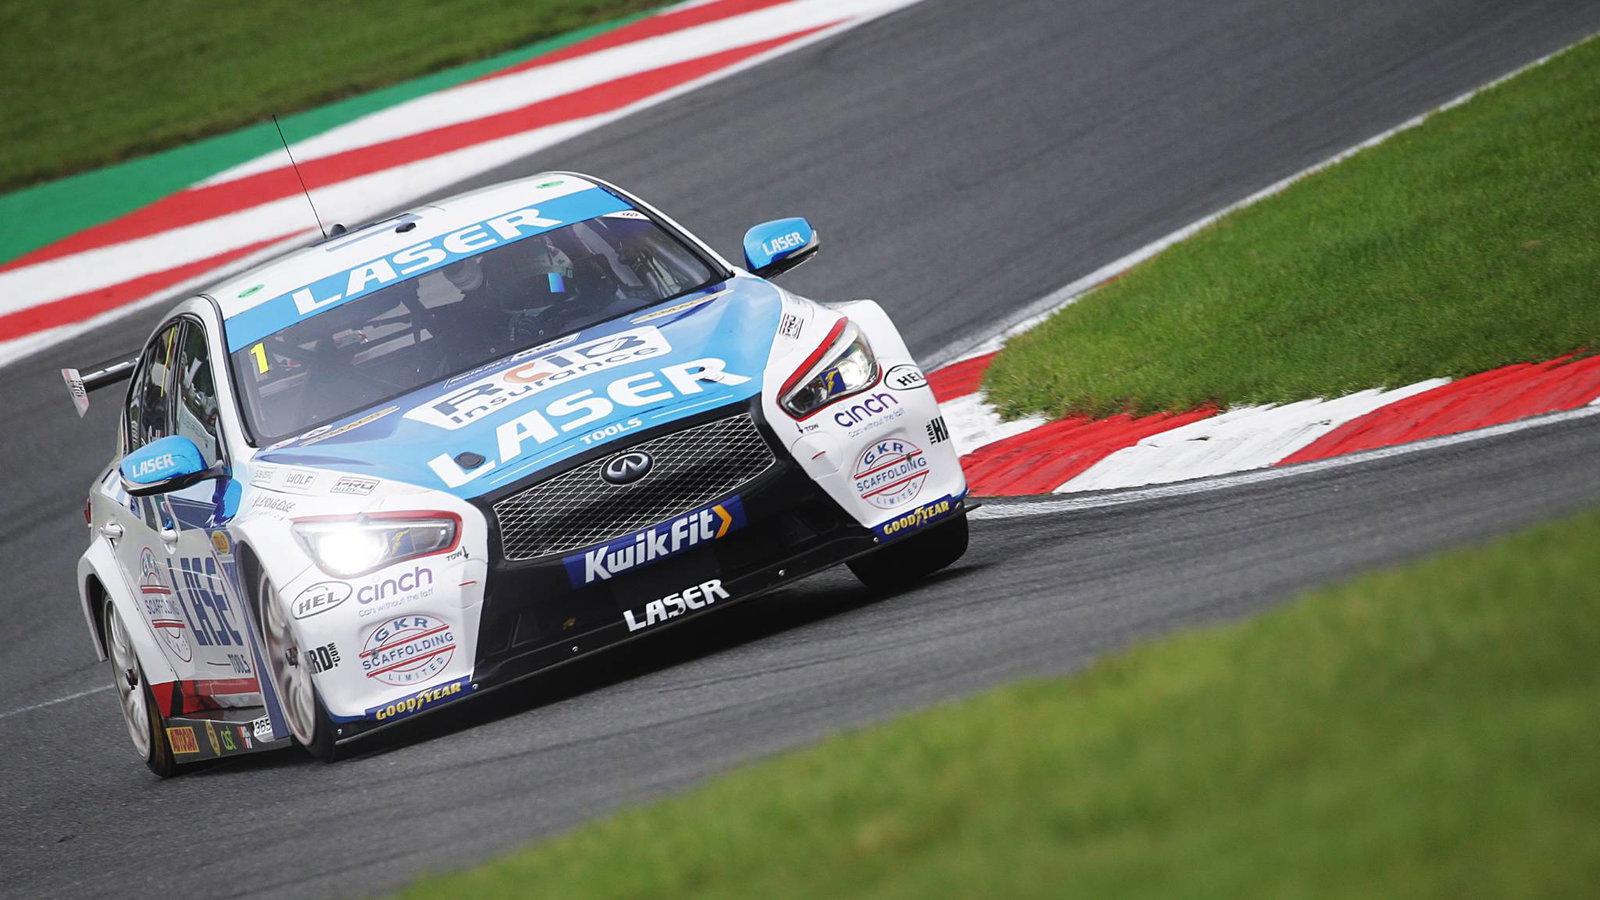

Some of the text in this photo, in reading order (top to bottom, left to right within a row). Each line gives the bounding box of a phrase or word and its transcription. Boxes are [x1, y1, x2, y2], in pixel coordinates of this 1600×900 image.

[762, 231, 805, 256] LASER
[292, 207, 563, 316] LASER
[249, 342, 270, 374] 1
[897, 371, 924, 387] HEL
[427, 357, 753, 488] LASER
[834, 393, 898, 428] cinch
[579, 417, 644, 445] TOOLS
[132, 453, 175, 479] LASER
[863, 442, 904, 466] GKR
[286, 472, 314, 486] WOLF
[856, 457, 927, 493] SCAFFOLDING
[876, 482, 918, 505] LIMITED
[883, 500, 950, 535] GOODYEAR
[446, 550, 463, 561] TOW
[357, 566, 433, 605] cinch
[297, 591, 341, 615] HEL
[623, 578, 730, 632] LASER
[375, 616, 429, 643] GKR
[362, 631, 454, 671] SCAFFOLDING
[388, 656, 444, 681] LIMITED
[376, 682, 462, 721] GOODYEAR
[254, 718, 272, 735] 365
